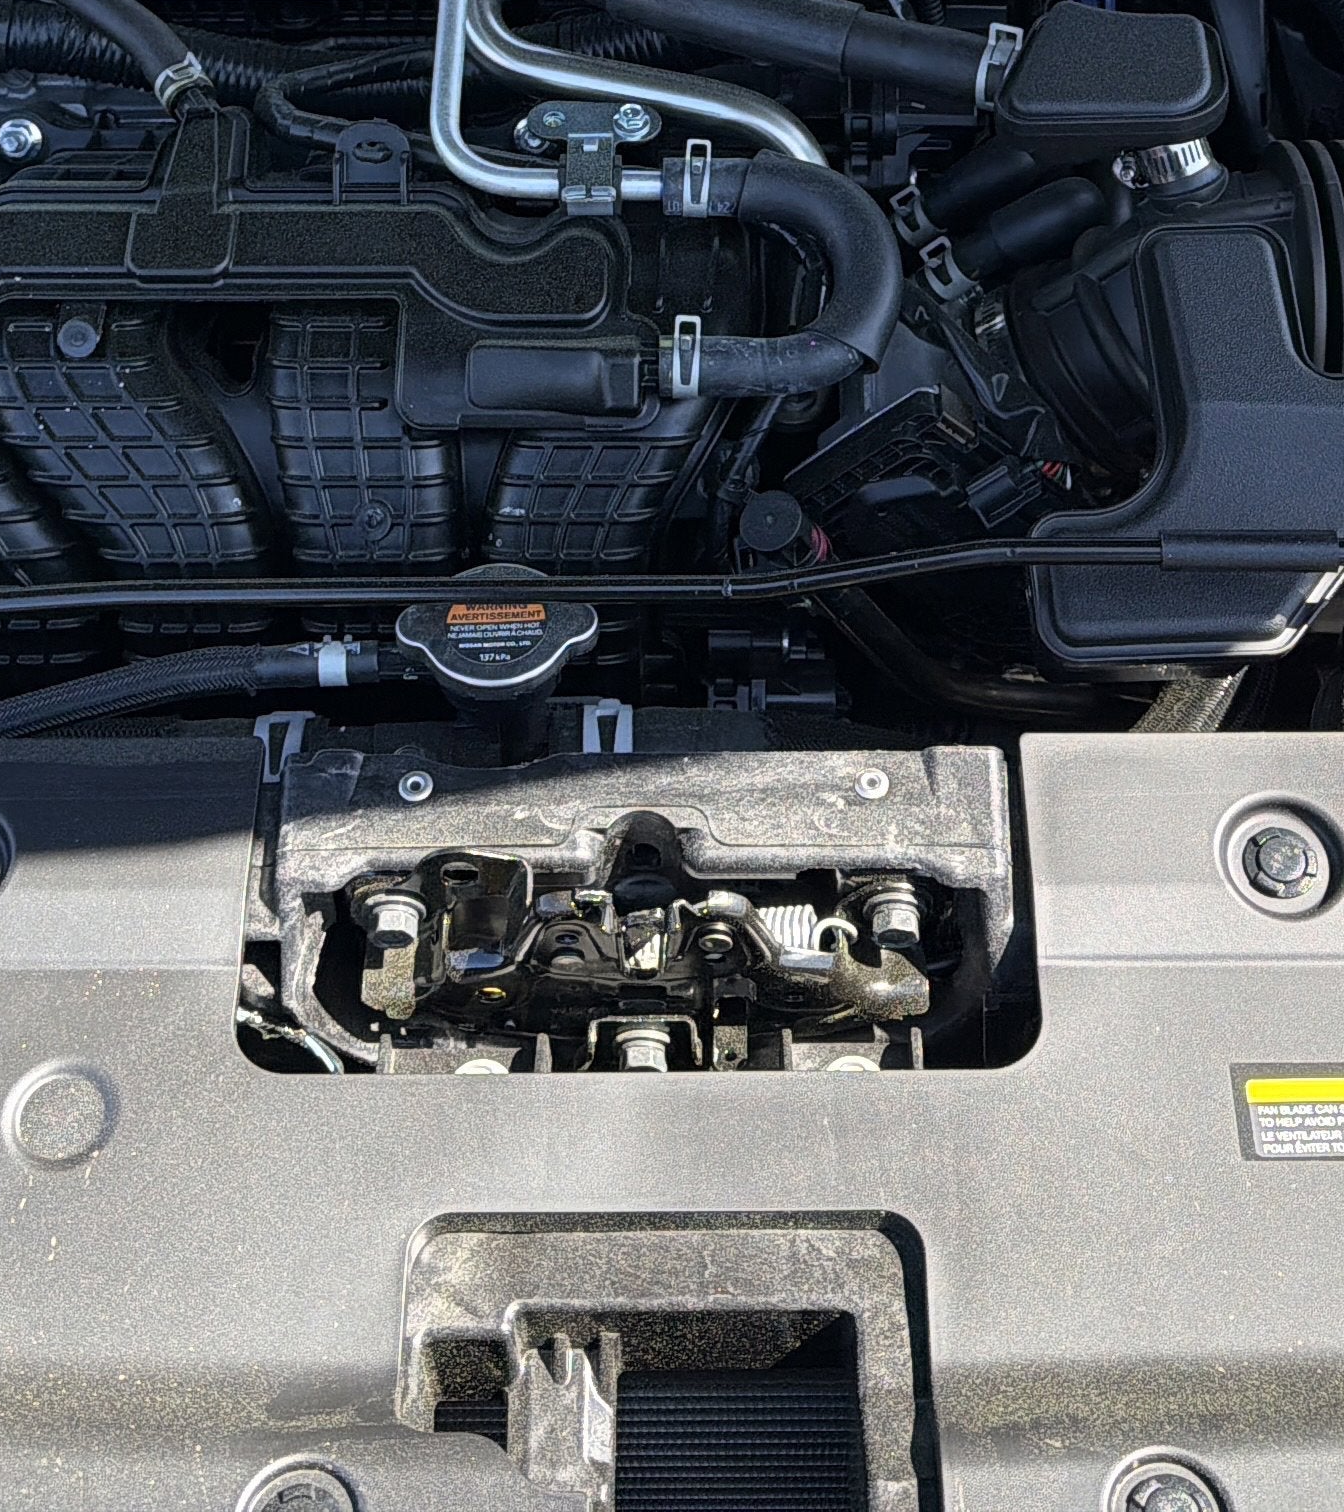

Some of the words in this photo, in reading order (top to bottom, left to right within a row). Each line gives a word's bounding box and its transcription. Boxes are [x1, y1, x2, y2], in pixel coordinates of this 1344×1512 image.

[450, 610, 542, 621] AVERTISSEMENT
[449, 624, 475, 632] NEVER
[479, 653, 494, 662] 137
[496, 653, 511, 661] kPa
[1258, 1105, 1278, 1116] FAN
[1280, 1105, 1313, 1115] BLADE
[1314, 1104, 1338, 1115] CAN
[1259, 1117, 1274, 1128] TO
[1276, 1117, 1303, 1127] HELP
[1304, 1116, 1336, 1126] AVOID
[1261, 1131, 1276, 1142] LE
[1276, 1129, 1343, 1141] VENTILATEUR
[1263, 1143, 1294, 1154] POUR
